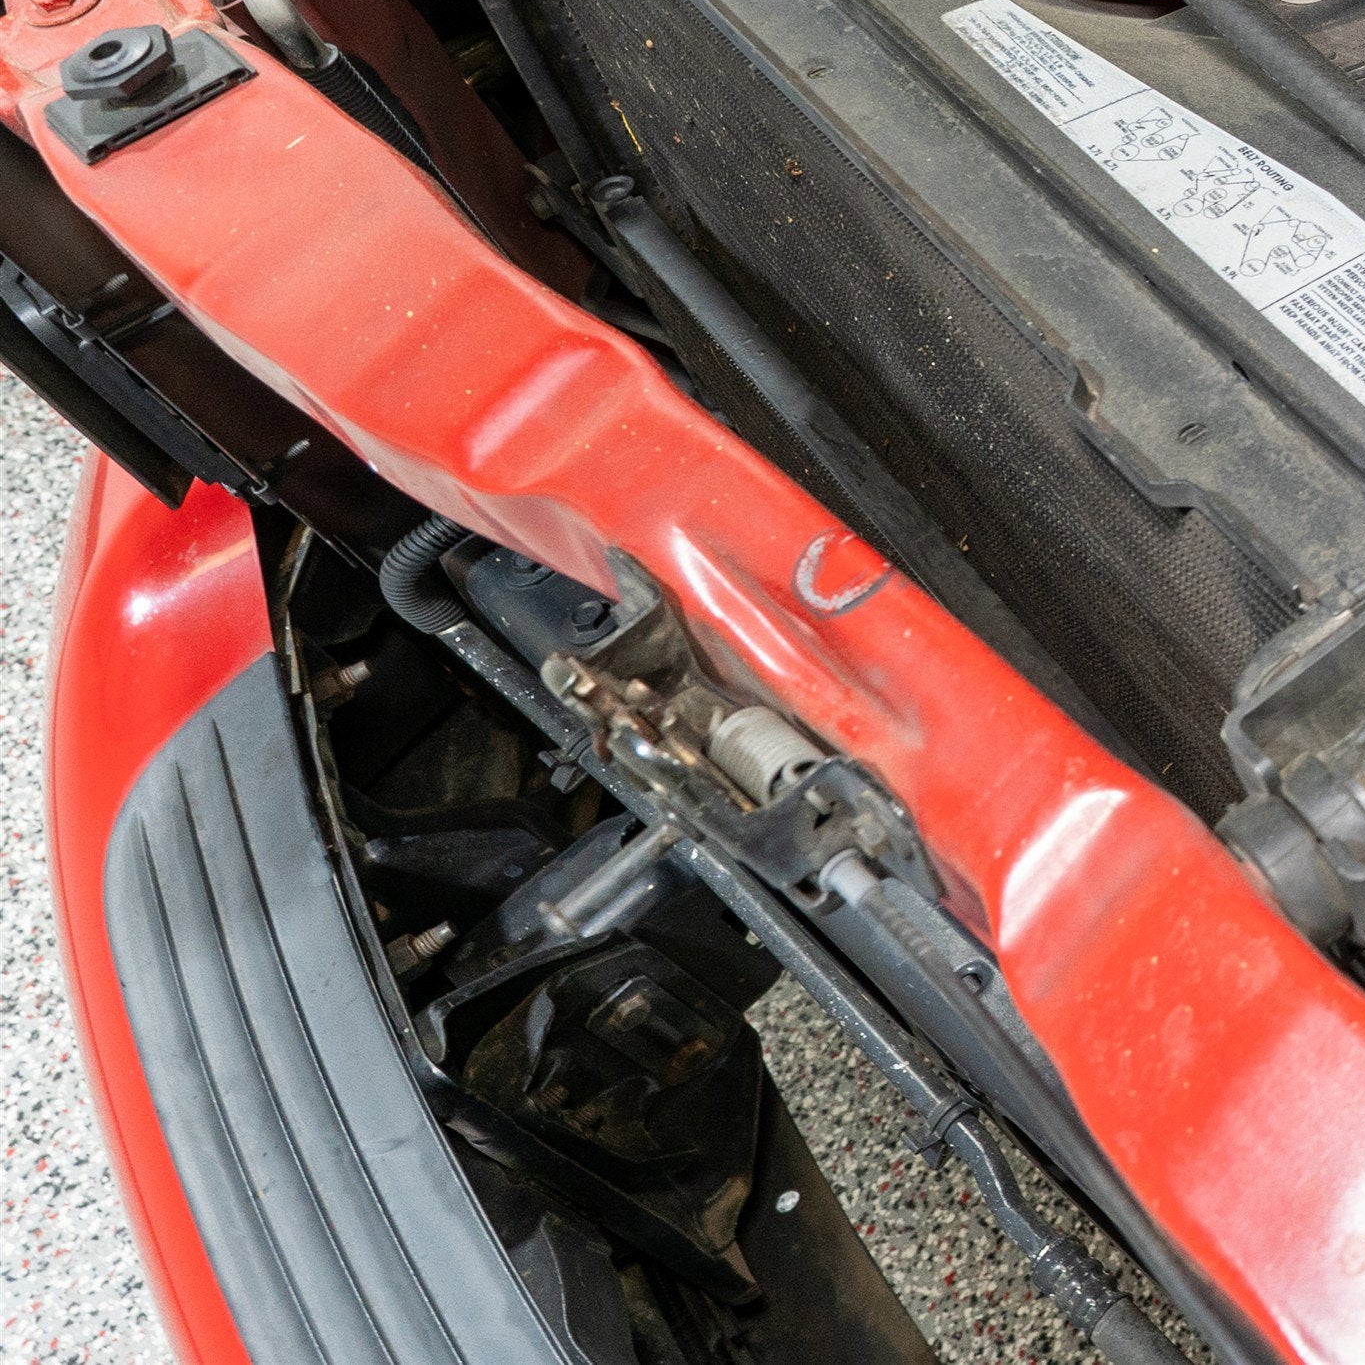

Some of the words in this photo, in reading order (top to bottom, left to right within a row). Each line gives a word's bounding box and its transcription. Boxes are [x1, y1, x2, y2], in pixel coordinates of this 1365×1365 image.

[1236, 145, 1260, 161] BELT
[1253, 160, 1296, 191] ROUTING
[1278, 304, 1298, 319] KEEP
[1293, 318, 1322, 340] HANDS
[1317, 338, 1342, 357] AWAY
[1336, 356, 1362, 375] FROM
[1287, 298, 1306, 311] FAN
[1301, 310, 1321, 325] MAY
[1316, 323, 1341, 342] START
[1336, 341, 1356, 355] ANY
[1298, 292, 1330, 317] SERIOUS
[1324, 315, 1354, 338] INJURY
